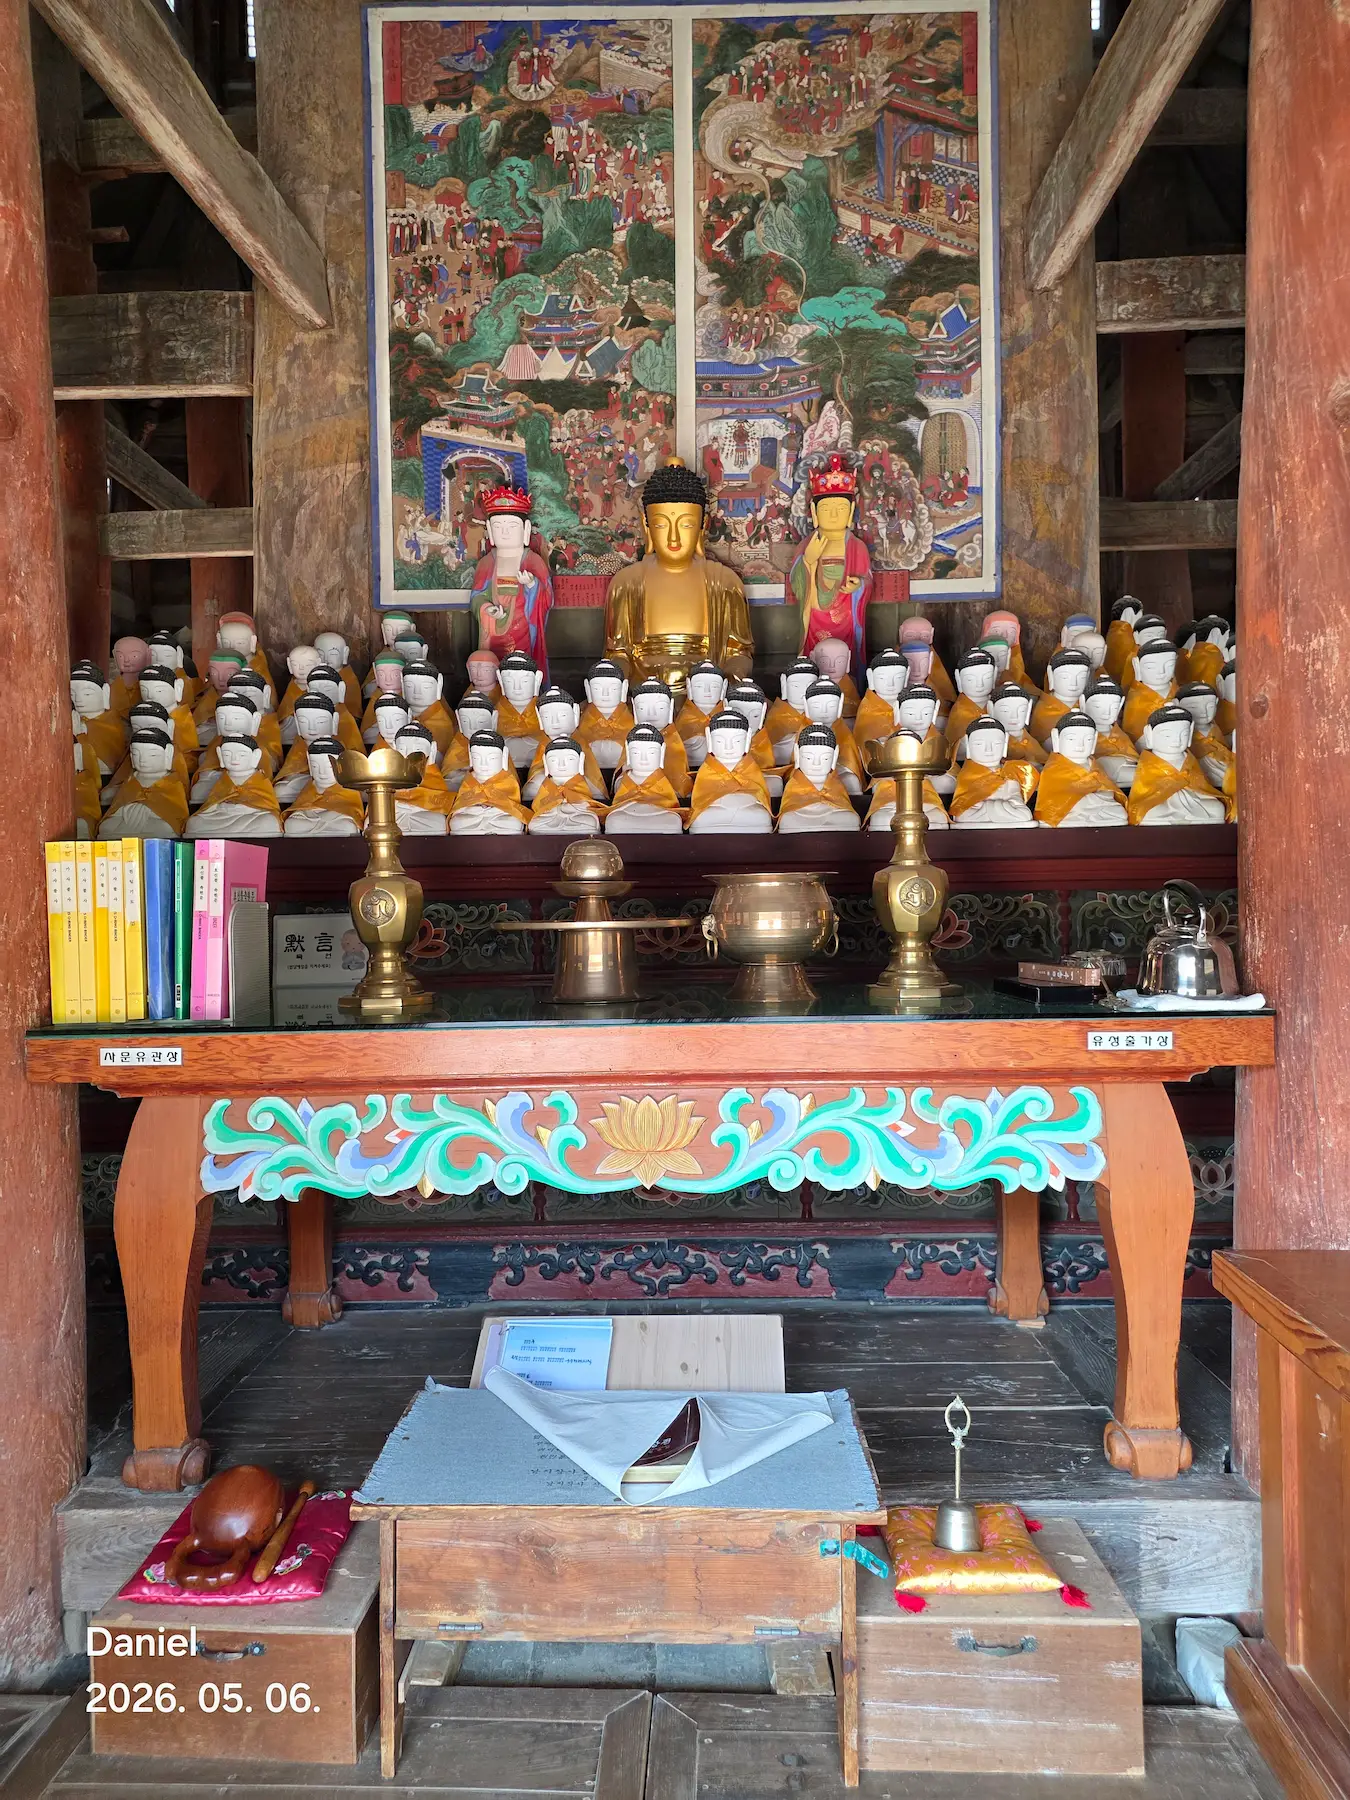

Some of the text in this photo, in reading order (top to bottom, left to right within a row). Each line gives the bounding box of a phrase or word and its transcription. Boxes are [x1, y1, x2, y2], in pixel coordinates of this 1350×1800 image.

[284, 932, 335, 953] 默言
[1092, 1035, 1168, 1047] 유성출가상
[104, 1051, 178, 1063] 사문유관상
